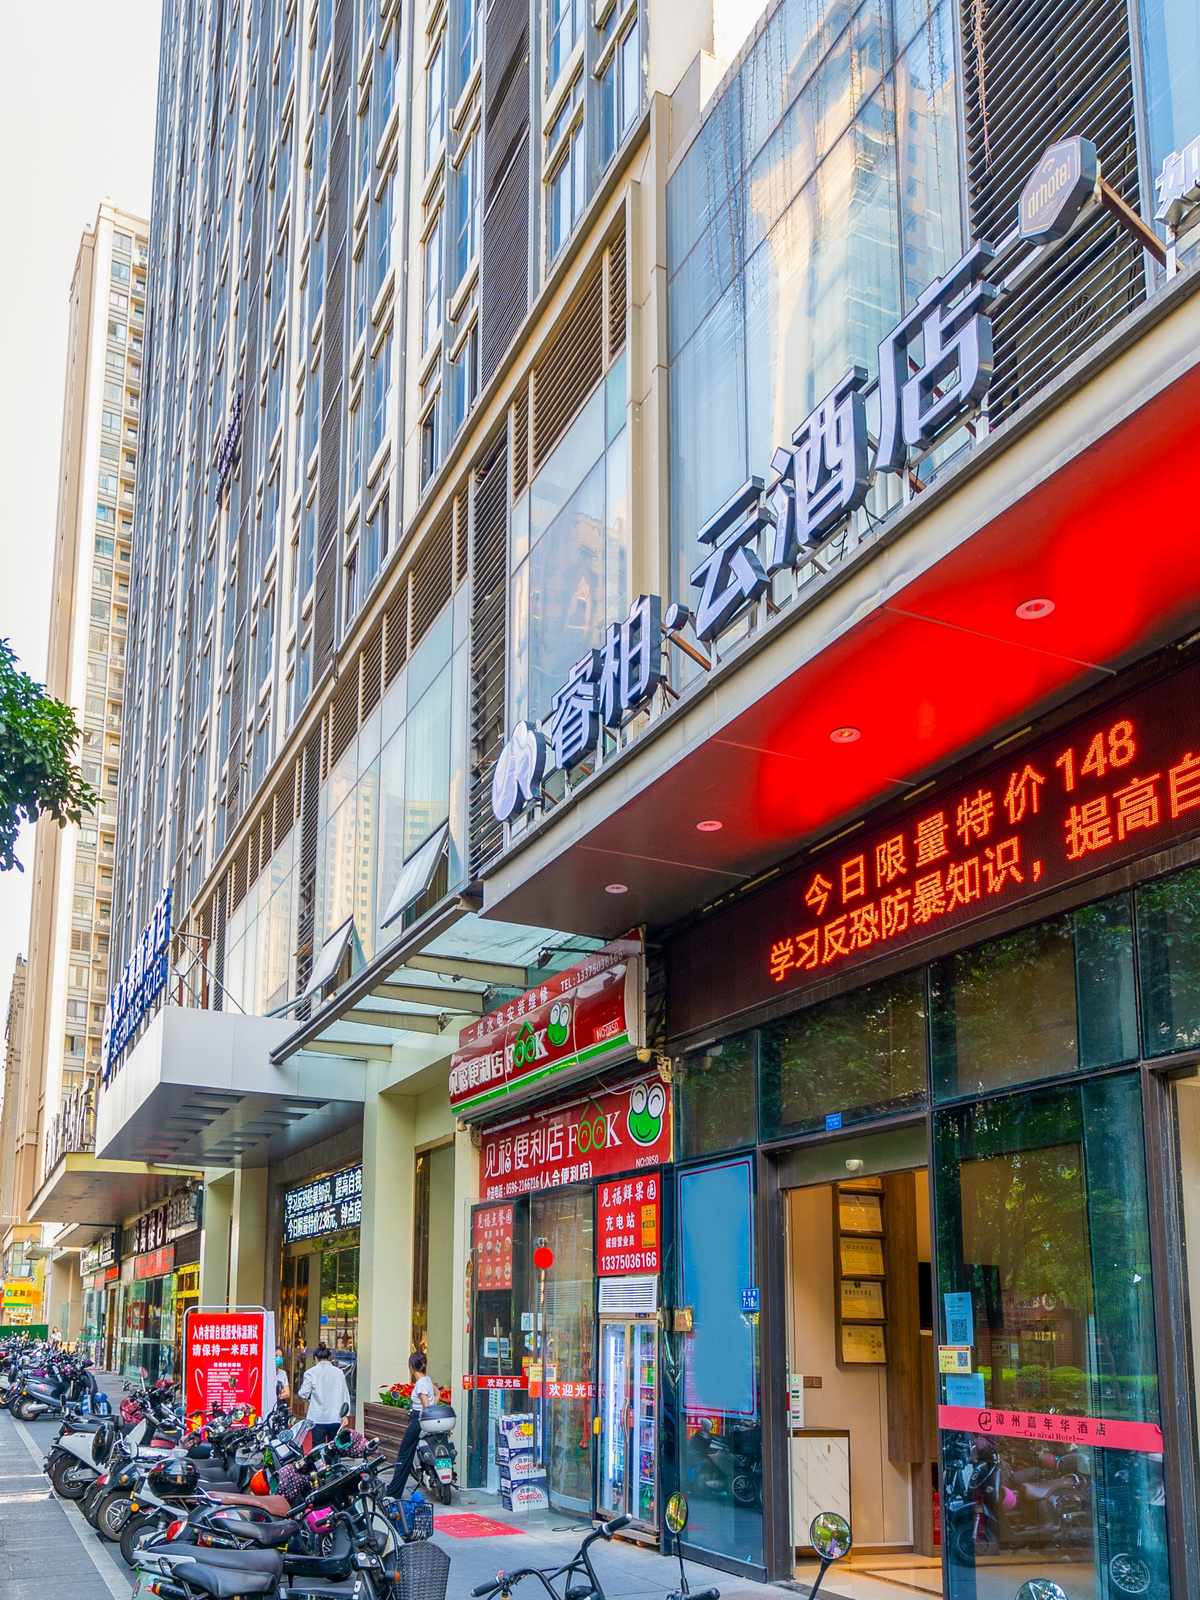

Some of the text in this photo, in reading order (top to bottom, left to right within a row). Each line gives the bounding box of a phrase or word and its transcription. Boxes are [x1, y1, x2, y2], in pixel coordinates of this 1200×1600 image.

[605, 1212, 635, 1232] 充电站
[601, 1251, 657, 1271] 13375036166
[192, 1343, 259, 1357] 请保持一米距离
[487, 1378, 521, 1388] 欢迎光临
[995, 1413, 1106, 1436] 漳州嘉年华酒店
